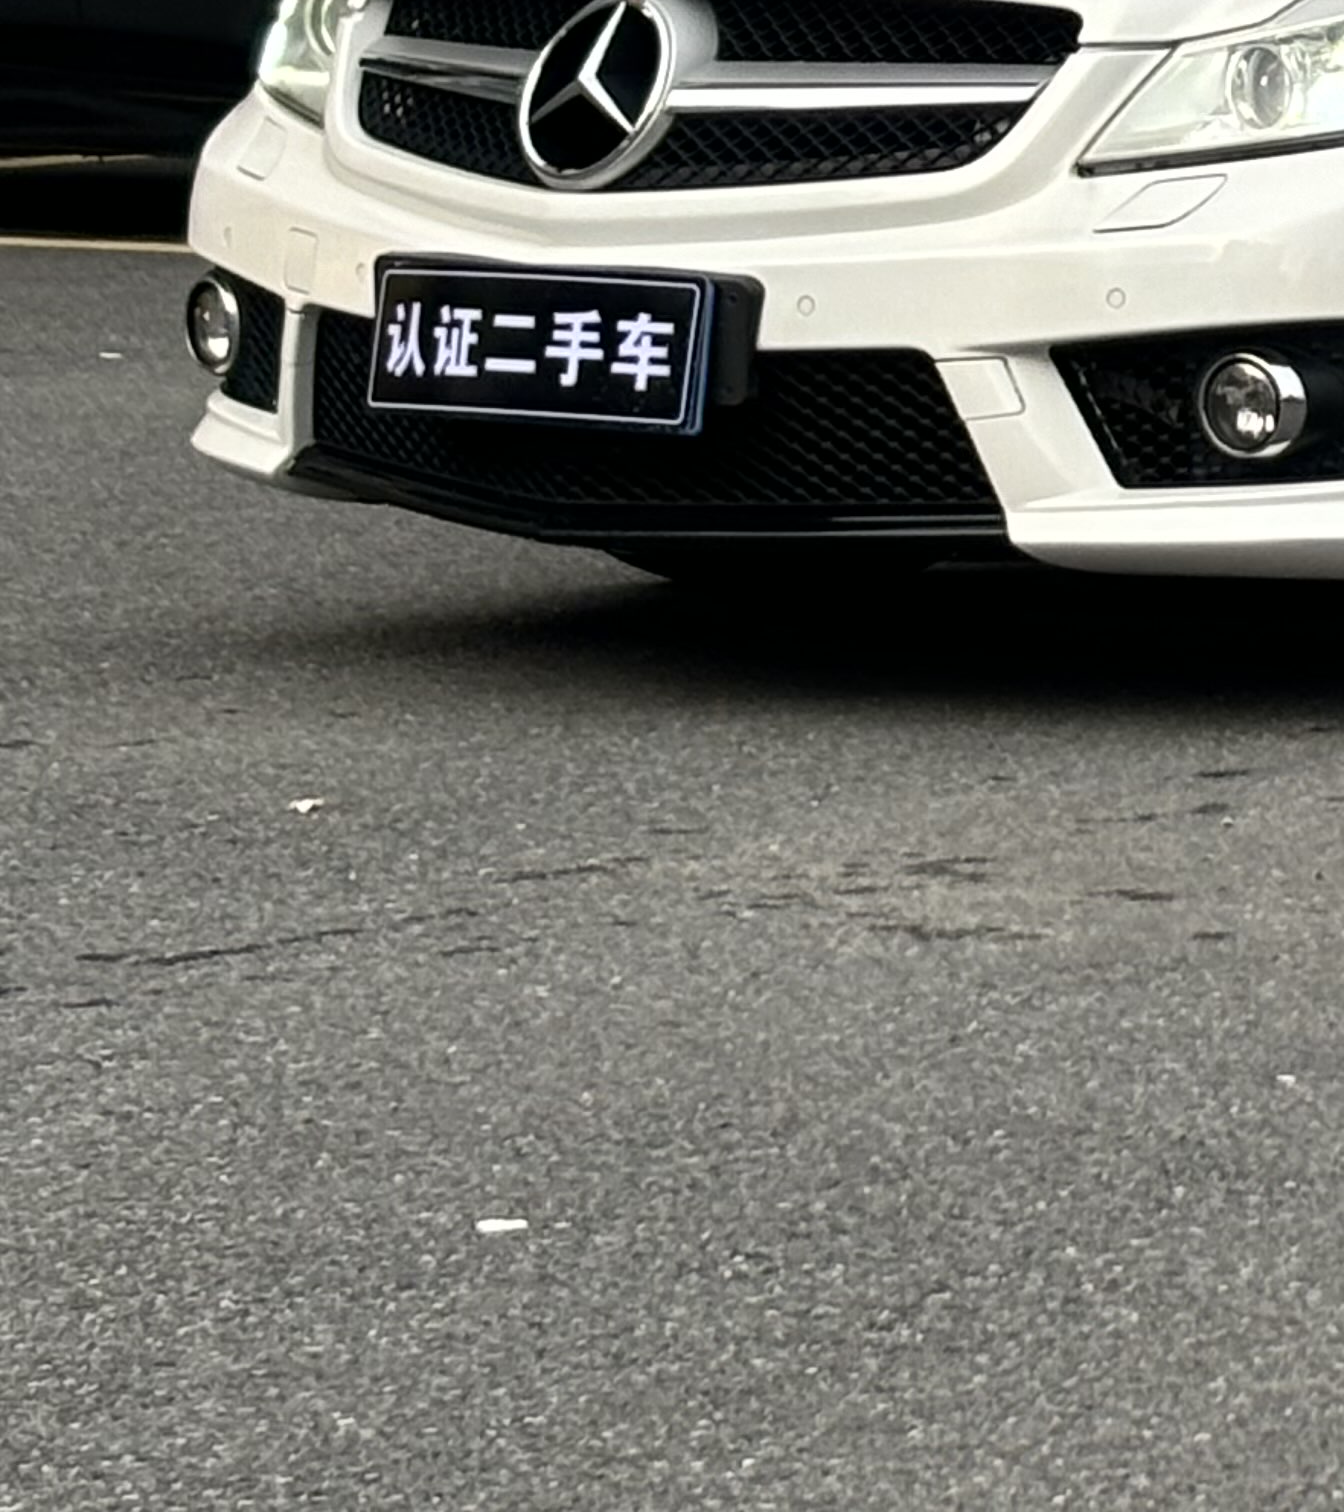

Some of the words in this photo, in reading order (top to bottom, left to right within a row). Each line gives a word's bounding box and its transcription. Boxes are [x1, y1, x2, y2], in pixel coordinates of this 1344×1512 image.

[386, 301, 675, 391] 认证二手车
